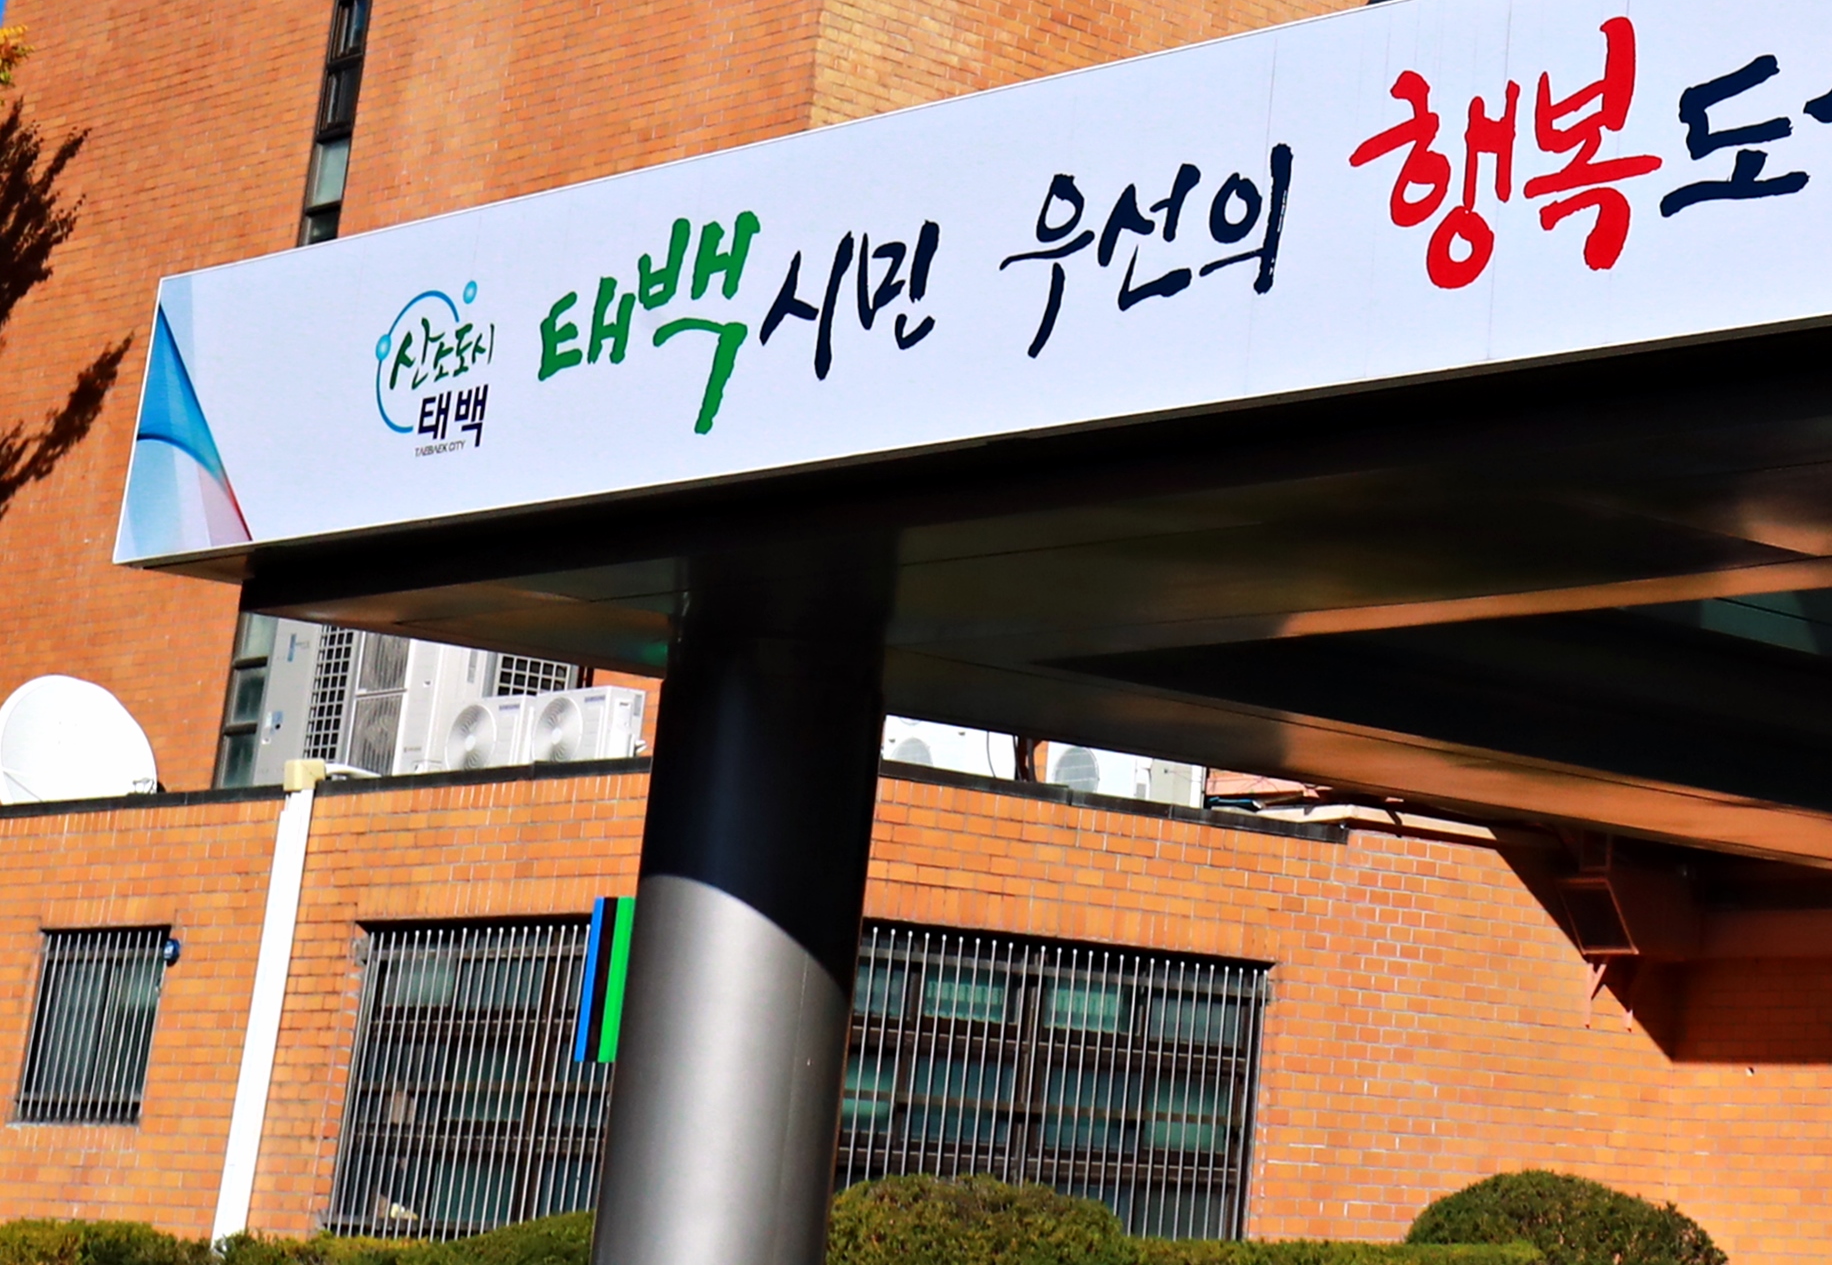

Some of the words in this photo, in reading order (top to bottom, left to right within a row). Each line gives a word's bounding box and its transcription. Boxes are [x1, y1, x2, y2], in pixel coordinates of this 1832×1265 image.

[1000, 143, 1294, 359] 우선의
[389, 316, 495, 391] 산소도시
[417, 383, 489, 448] 태백
[448, 439, 466, 452] CITY
